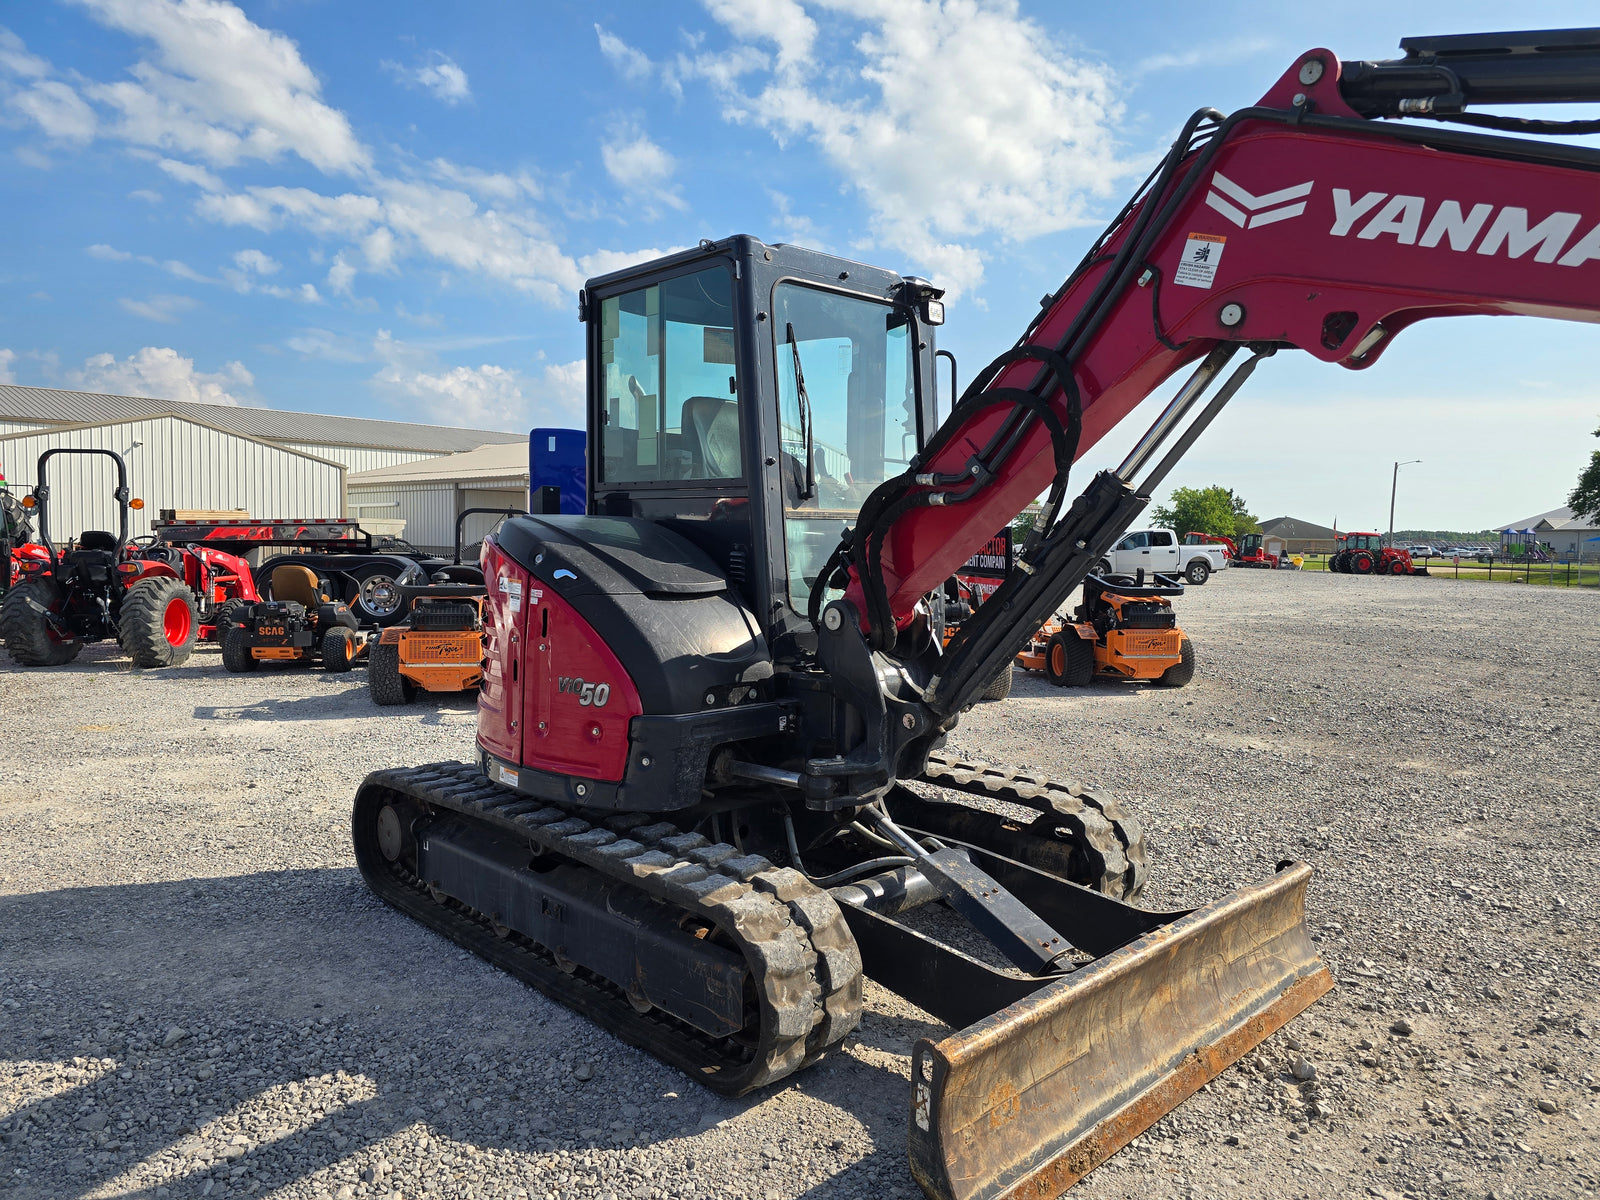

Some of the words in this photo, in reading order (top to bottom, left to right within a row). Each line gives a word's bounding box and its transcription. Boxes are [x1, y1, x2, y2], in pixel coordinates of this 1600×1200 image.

[977, 537, 1006, 556] ACTOR
[967, 554, 979, 567] ENT
[979, 555, 1006, 569] COMPANY
[259, 627, 285, 636] SCAG
[943, 627, 960, 636] SC
